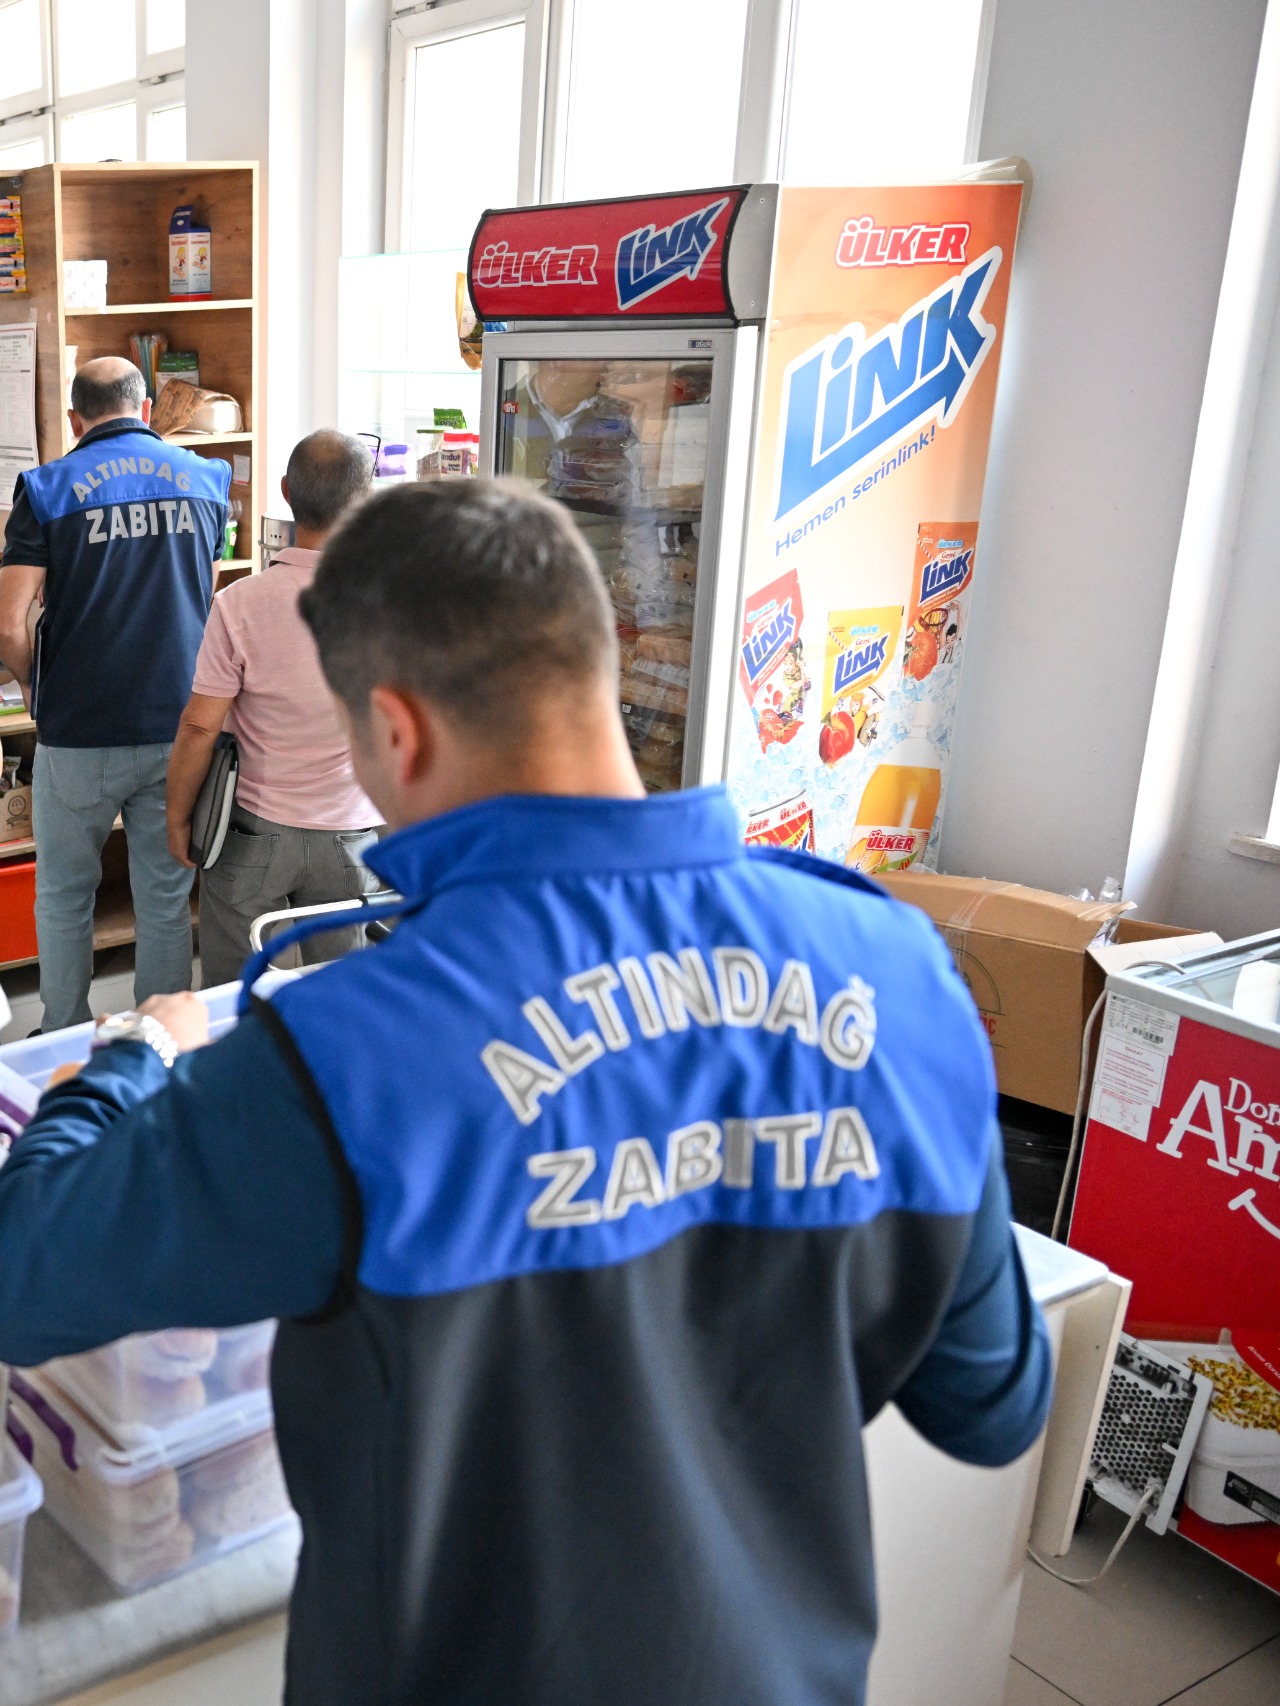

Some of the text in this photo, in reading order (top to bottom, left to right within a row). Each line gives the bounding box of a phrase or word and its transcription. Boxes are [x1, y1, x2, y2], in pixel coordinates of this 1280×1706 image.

[478, 241, 598, 288] ÜLKER
[835, 215, 971, 268] ÜLKER
[72, 457, 193, 505] ALTINDAĞ
[775, 424, 936, 557] Hemen serinlink!
[86, 500, 197, 545] ZABITA
[866, 830, 916, 853] ÜLKER
[480, 946, 877, 1126] ALTINDAĞ
[527, 1106, 880, 1229] ZABITA
